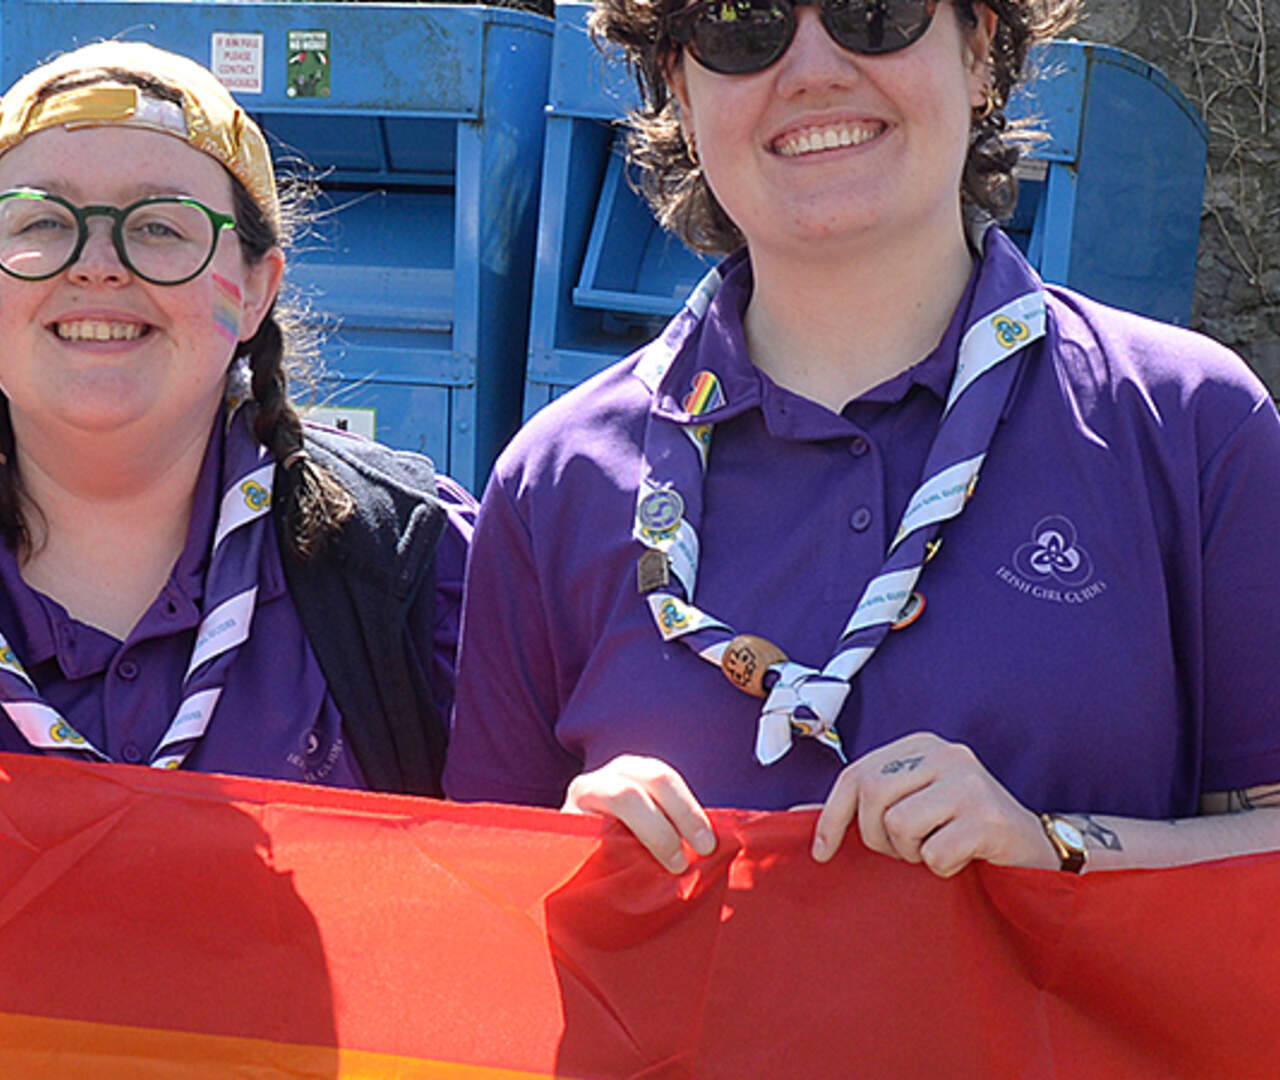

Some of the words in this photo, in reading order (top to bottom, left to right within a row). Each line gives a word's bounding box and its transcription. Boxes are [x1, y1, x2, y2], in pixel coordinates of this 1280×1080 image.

[995, 565, 1032, 594] IRISH
[1032, 585, 1063, 603] GIRL
[1064, 580, 1107, 604] GUIDES
